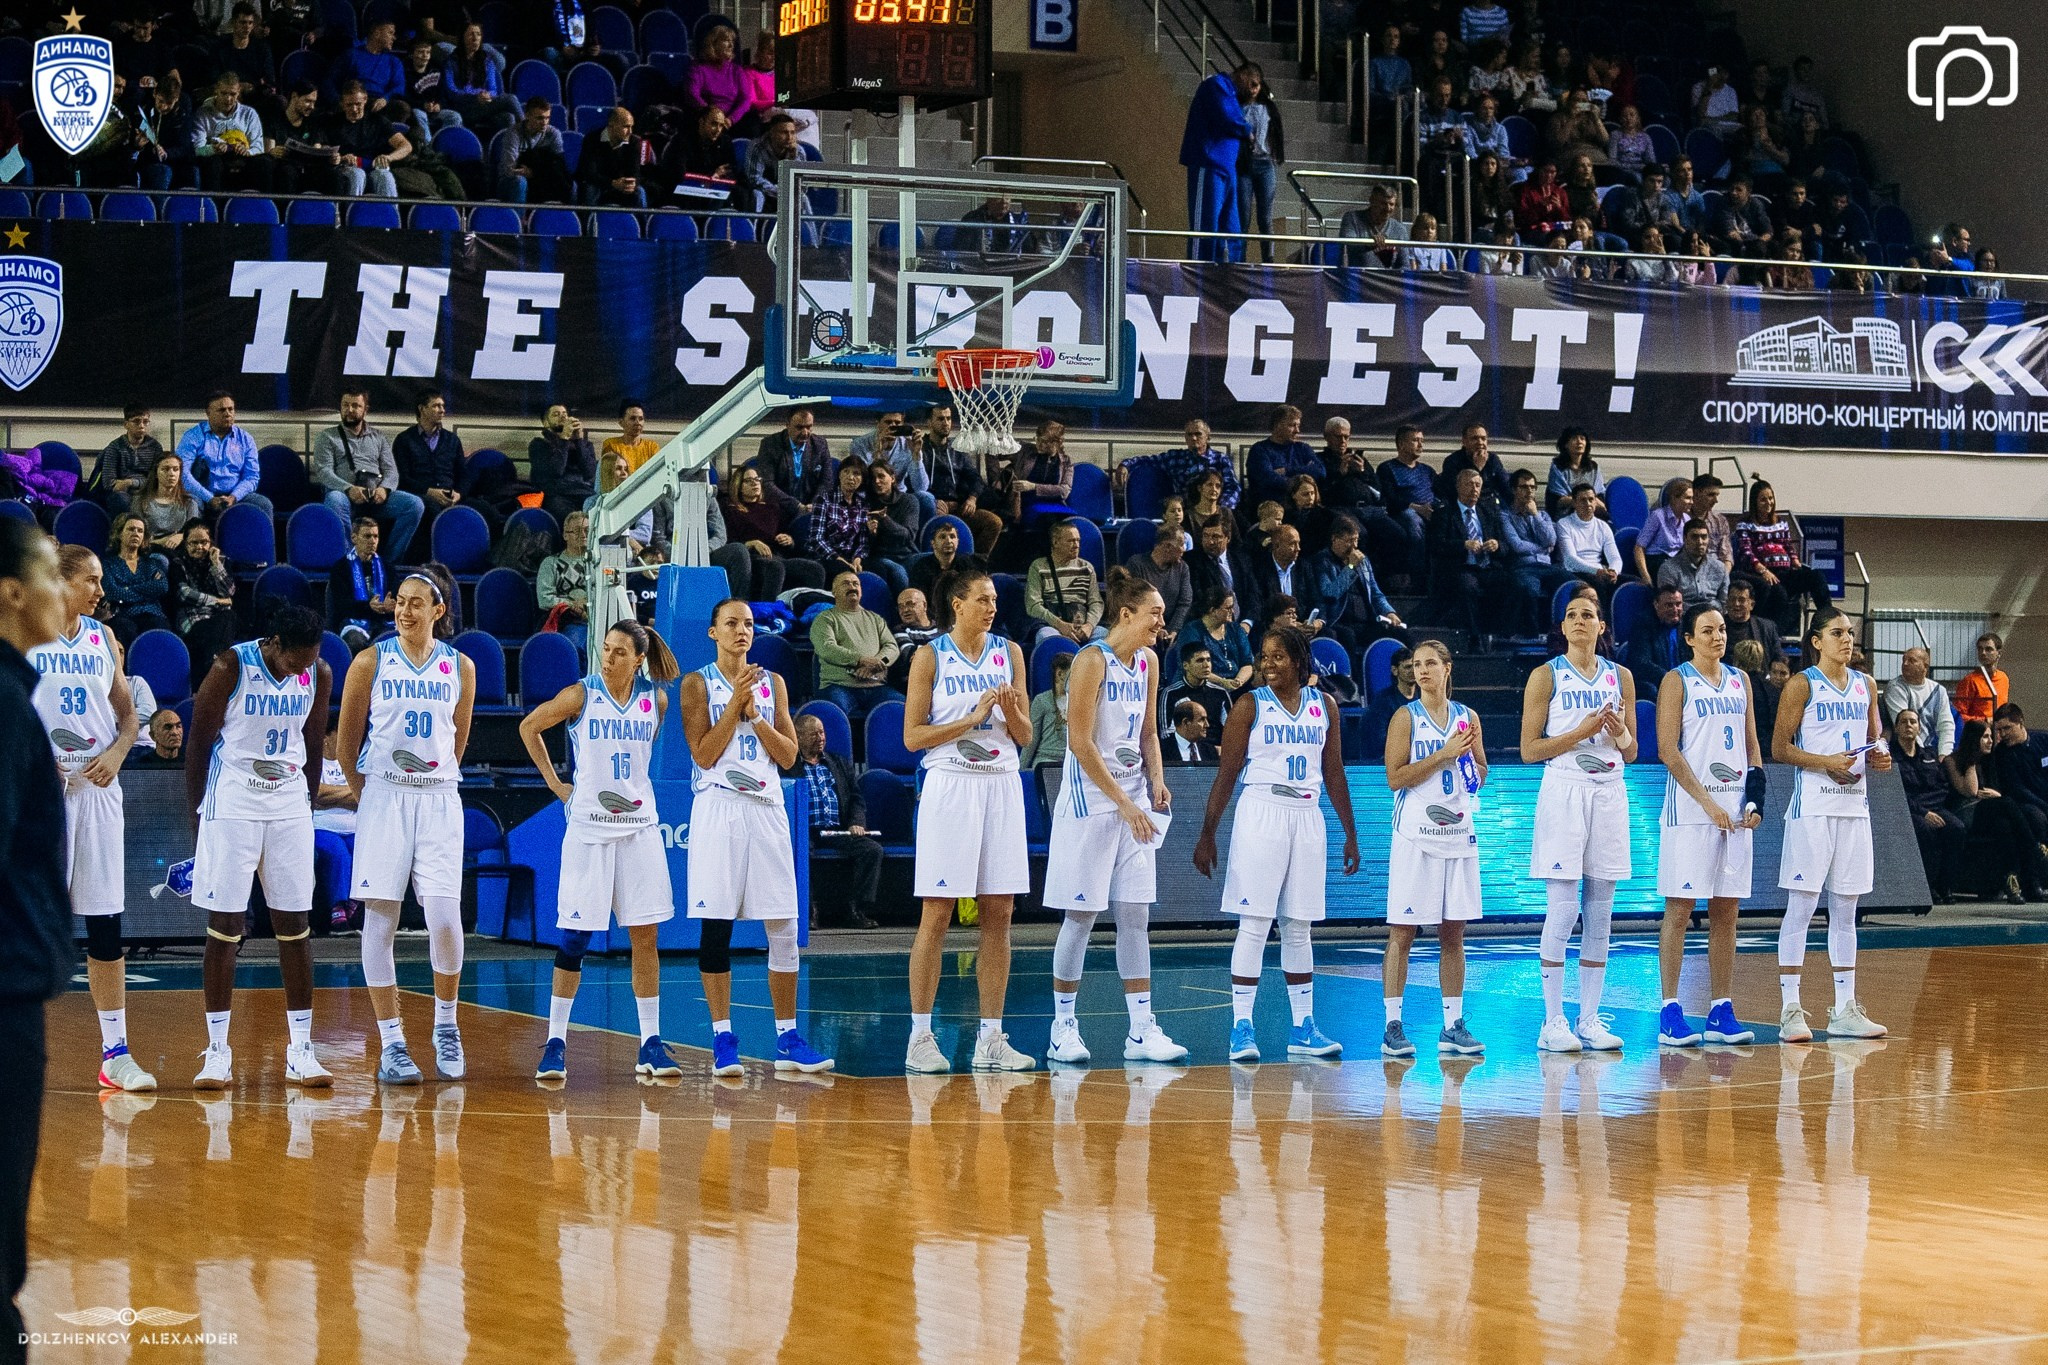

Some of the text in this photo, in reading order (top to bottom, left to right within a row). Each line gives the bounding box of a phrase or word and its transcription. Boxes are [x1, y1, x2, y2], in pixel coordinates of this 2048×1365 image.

[852, 77, 883, 90] MegaS
[0, 262, 56, 284] НАМО
[229, 260, 565, 382] THE
[1058, 352, 1101, 362] EuroLeague
[1702, 400, 2048, 433] СПОРТИВНО-КОНЦЕРТНЫЙ КОМПЛЕ
[36, 652, 104, 676] DYNAMO
[60, 686, 87, 715] 33
[381, 679, 451, 703] DYNAMO
[1107, 681, 1143, 702] DYNA
[244, 694, 310, 716] DYNAMO
[405, 710, 432, 739] 30
[589, 718, 653, 742] DYNAMO
[1264, 724, 1324, 746] DYNAMO
[265, 728, 289, 756] 31
[738, 735, 757, 761] 13
[1415, 739, 1446, 760] DYN
[1723, 726, 1734, 751] 3
[1843, 730, 1851, 752] 1
[54, 753, 97, 763] etalloinv
[611, 752, 631, 780] 15
[1286, 755, 1307, 781] 10
[1442, 769, 1454, 795] 9
[1704, 784, 1745, 793] Metalloinves
[1419, 826, 1469, 836] Metalloinvest
